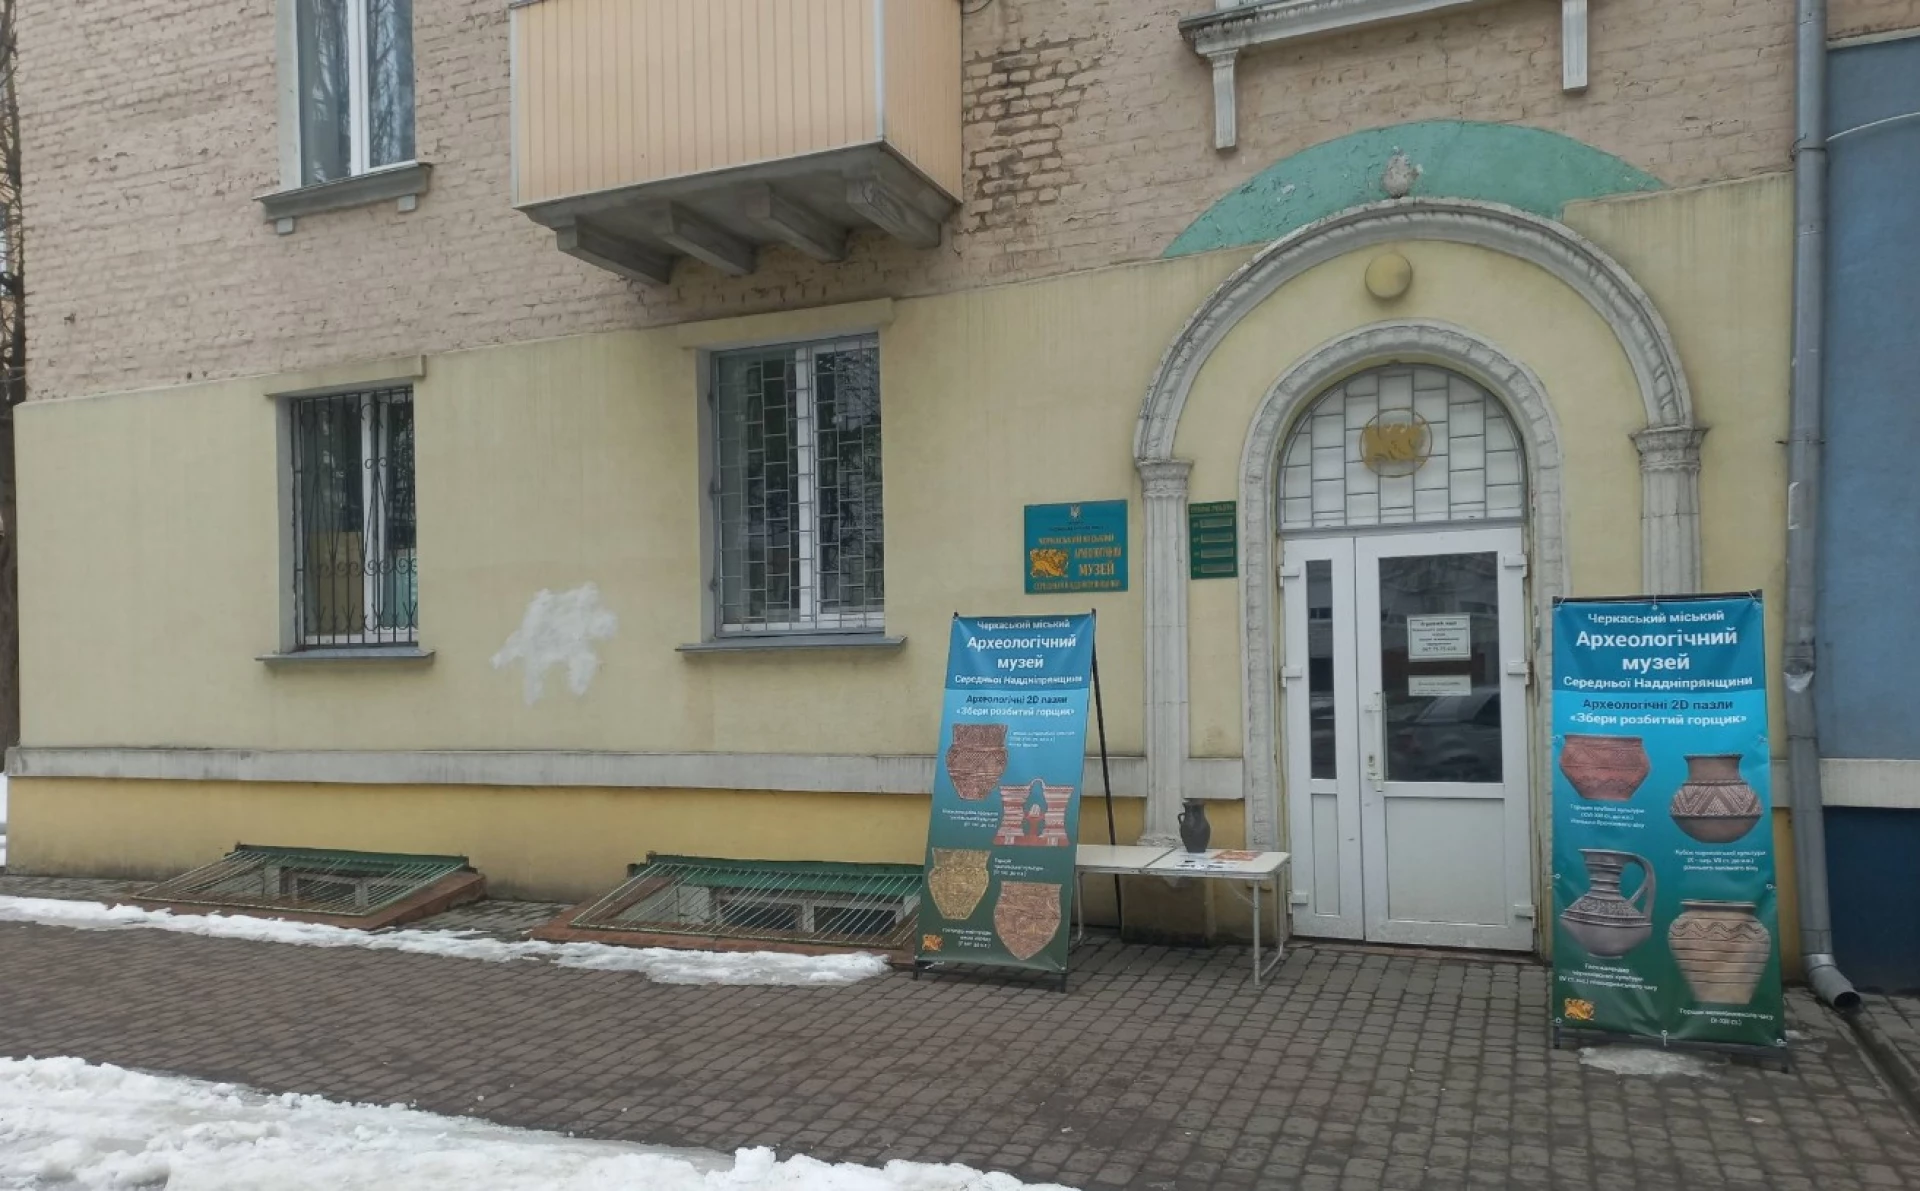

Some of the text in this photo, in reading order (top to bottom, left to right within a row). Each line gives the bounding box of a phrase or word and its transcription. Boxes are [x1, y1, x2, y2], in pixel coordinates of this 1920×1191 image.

[1079, 560, 1114, 576] МУЗЕЙ
[977, 619, 1070, 631] Черкаський міський
[1588, 611, 1725, 625] Черкаський міський
[967, 634, 1076, 652] Археологічний
[1576, 627, 1738, 650] Археологічний
[997, 655, 1044, 671] музей
[1622, 652, 1690, 674] музей
[955, 675, 1082, 685] Середньої Наддніпрянщини
[1563, 676, 1753, 690] Середньої Наддніпрянщини
[966, 695, 1068, 705] Археологічні 2D пазли
[1583, 699, 1733, 710] Археологічні 2D пазли
[956, 707, 1075, 717] «Збери розбитий горщик»
[1570, 713, 1747, 726] «Збери розбитий горщик»
